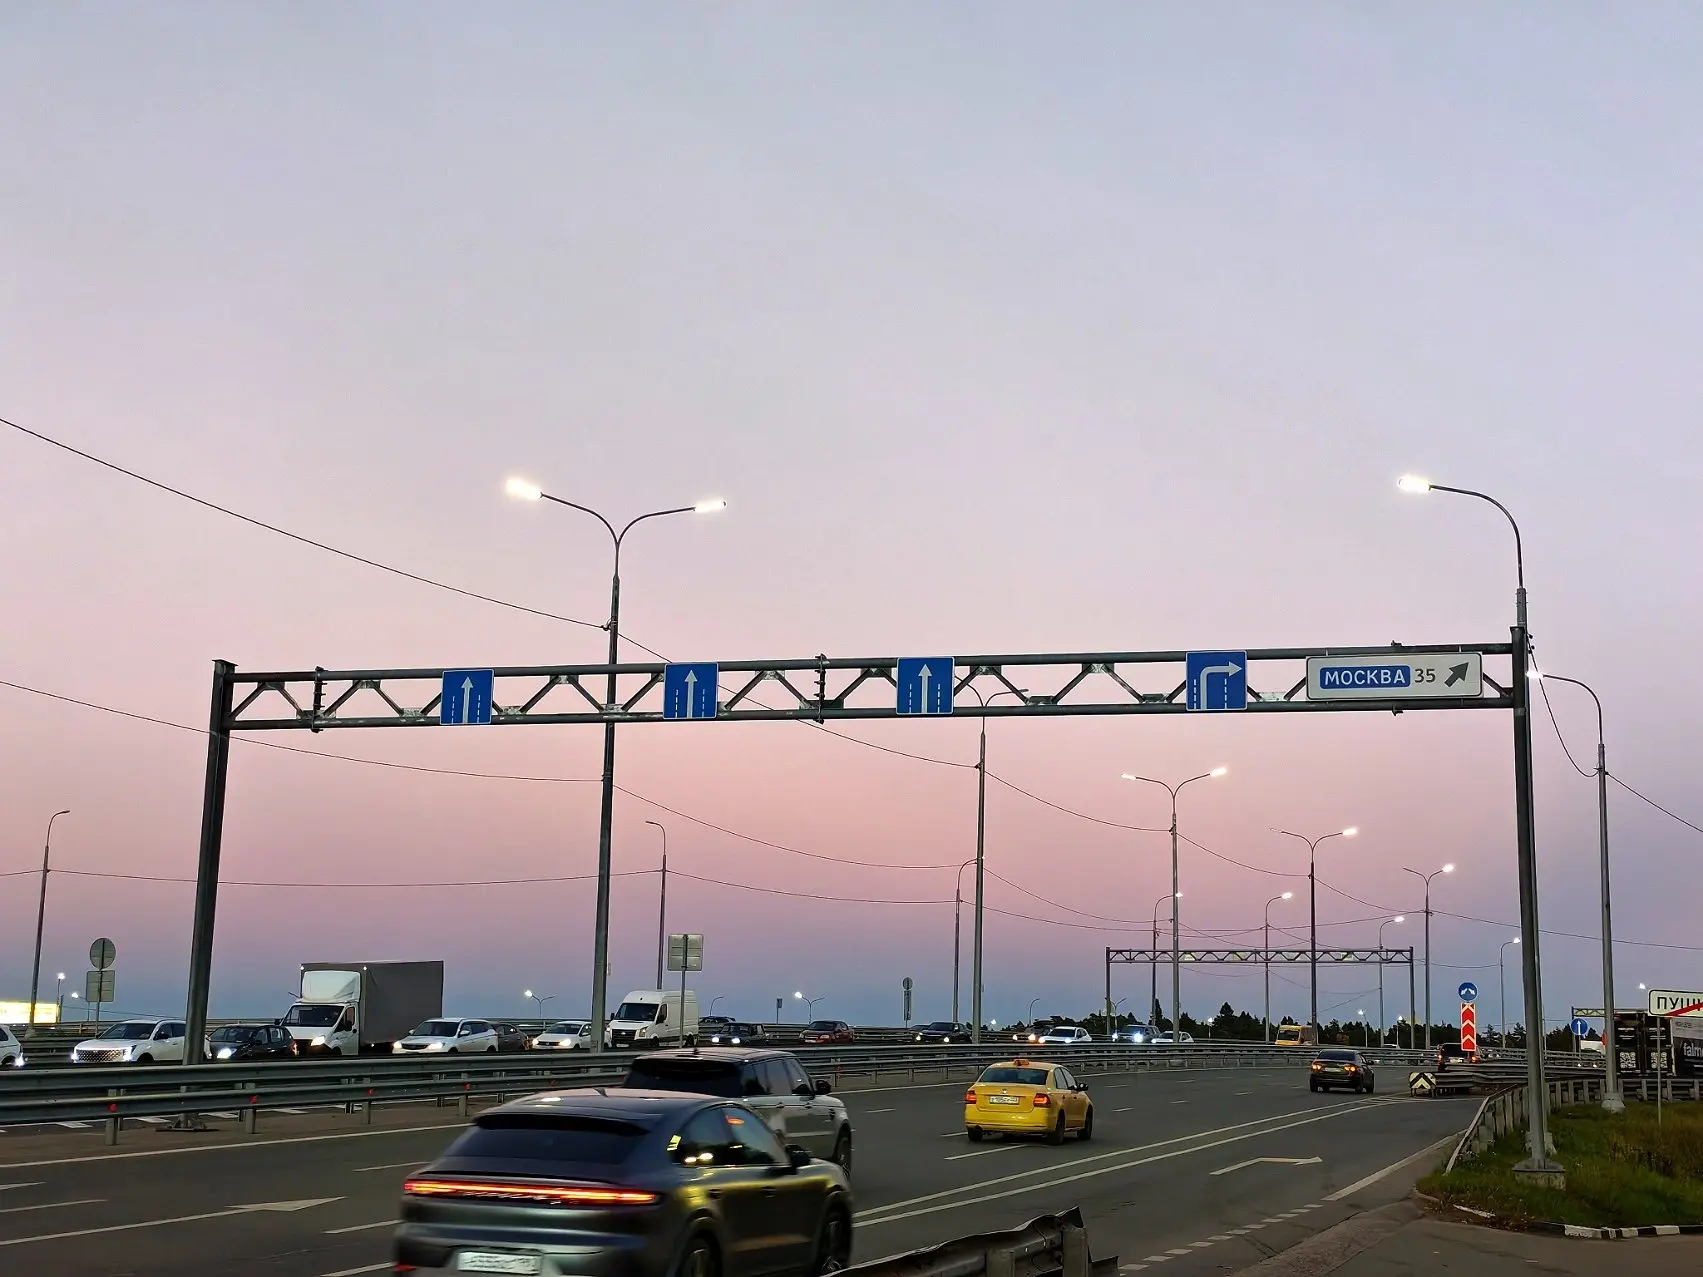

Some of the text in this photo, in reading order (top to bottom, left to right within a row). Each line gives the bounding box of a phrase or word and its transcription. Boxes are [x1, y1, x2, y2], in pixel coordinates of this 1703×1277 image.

[1324, 668, 1436, 686] МОСКВА 35
[1657, 996, 1703, 1011] ПУШ
